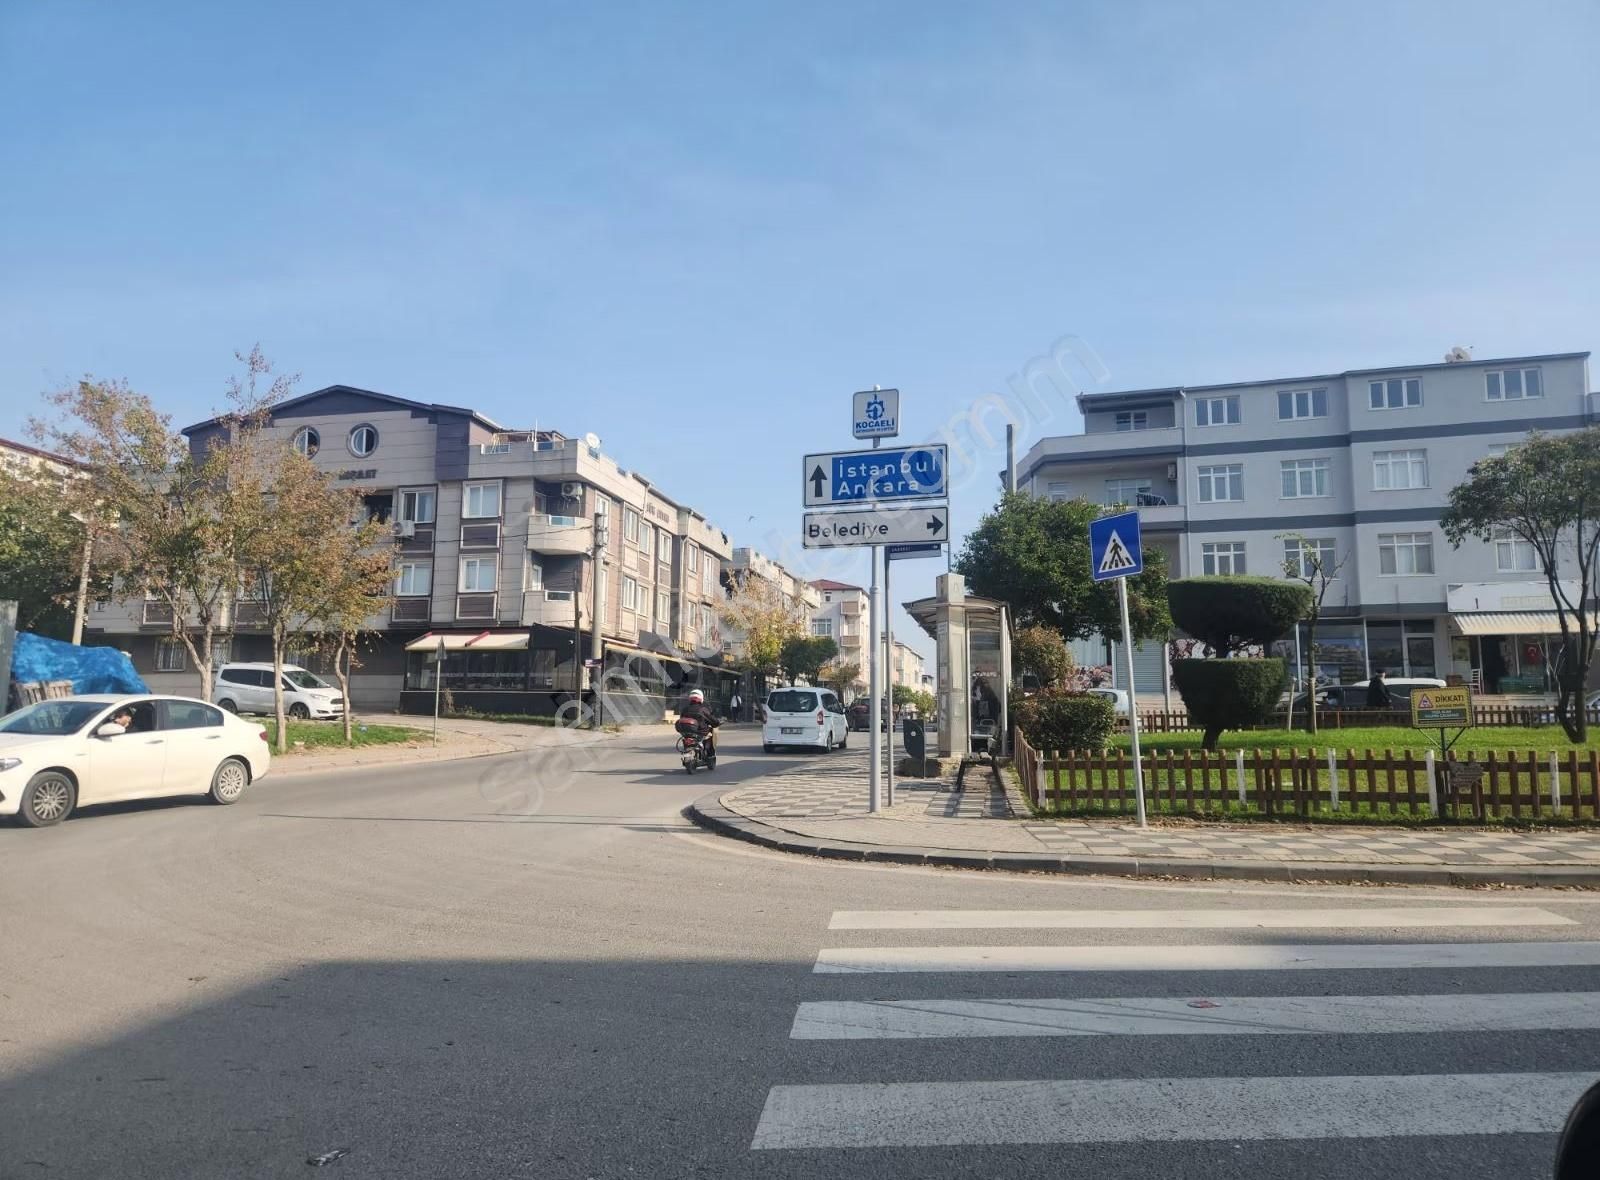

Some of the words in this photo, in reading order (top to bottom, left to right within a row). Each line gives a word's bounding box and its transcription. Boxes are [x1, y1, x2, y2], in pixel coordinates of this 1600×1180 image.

[855, 418, 894, 428] KOCAELİ
[839, 458, 936, 478] İstanbul
[838, 480, 919, 496] Ankara
[808, 521, 889, 539] Belediye
